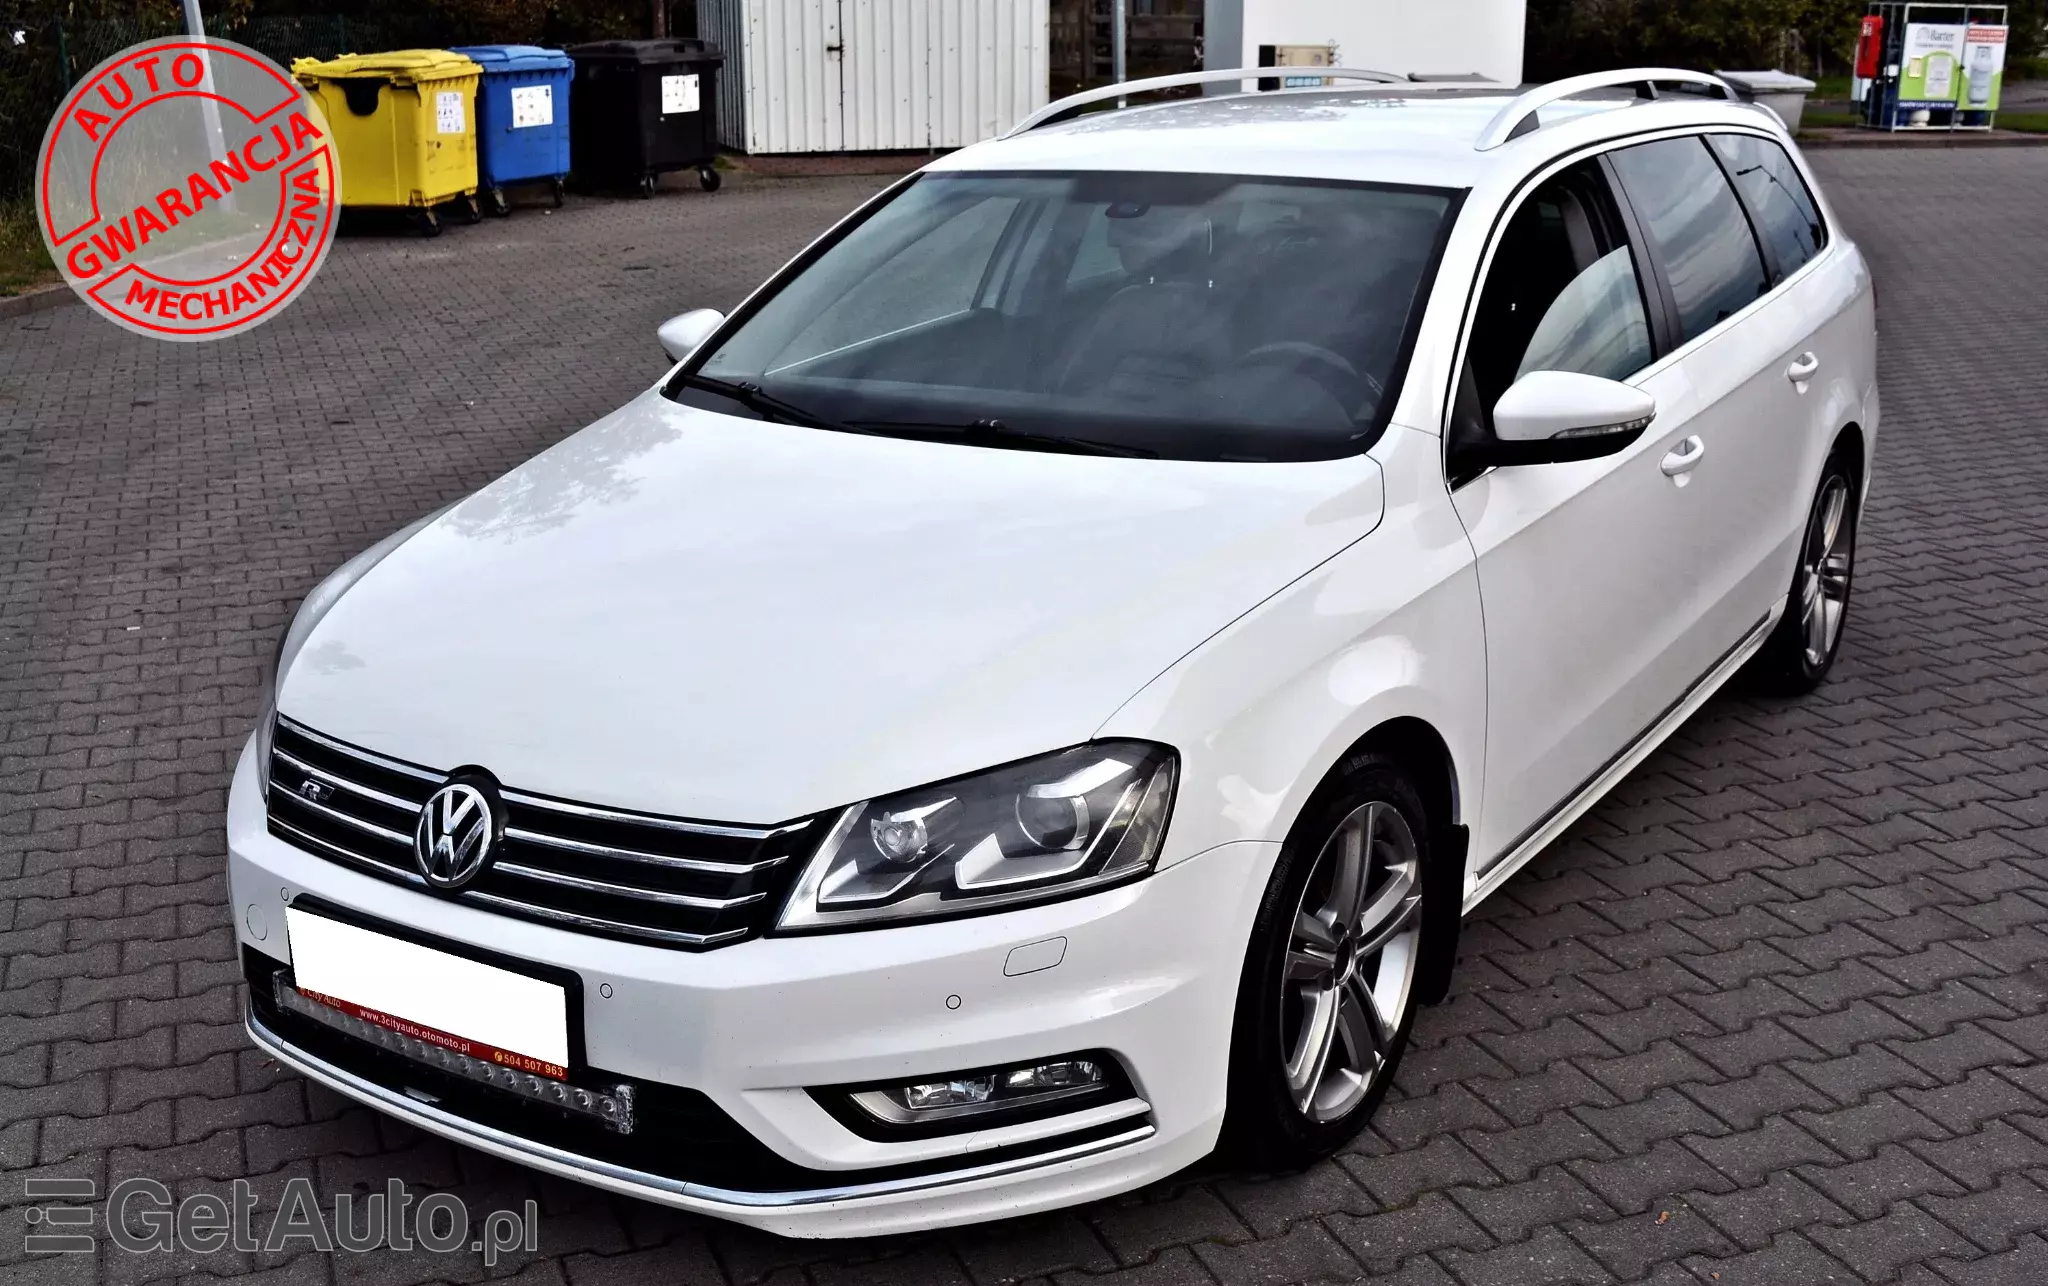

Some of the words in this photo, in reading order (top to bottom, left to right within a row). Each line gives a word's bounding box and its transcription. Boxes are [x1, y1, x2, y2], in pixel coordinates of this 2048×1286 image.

[323, 995, 341, 1008] Auto
[359, 1009, 470, 1053] www.3cityauto.otomoto.pl
[504, 1053, 521, 1067] 504
[524, 1059, 542, 1072] 507
[545, 1064, 564, 1078] 963
